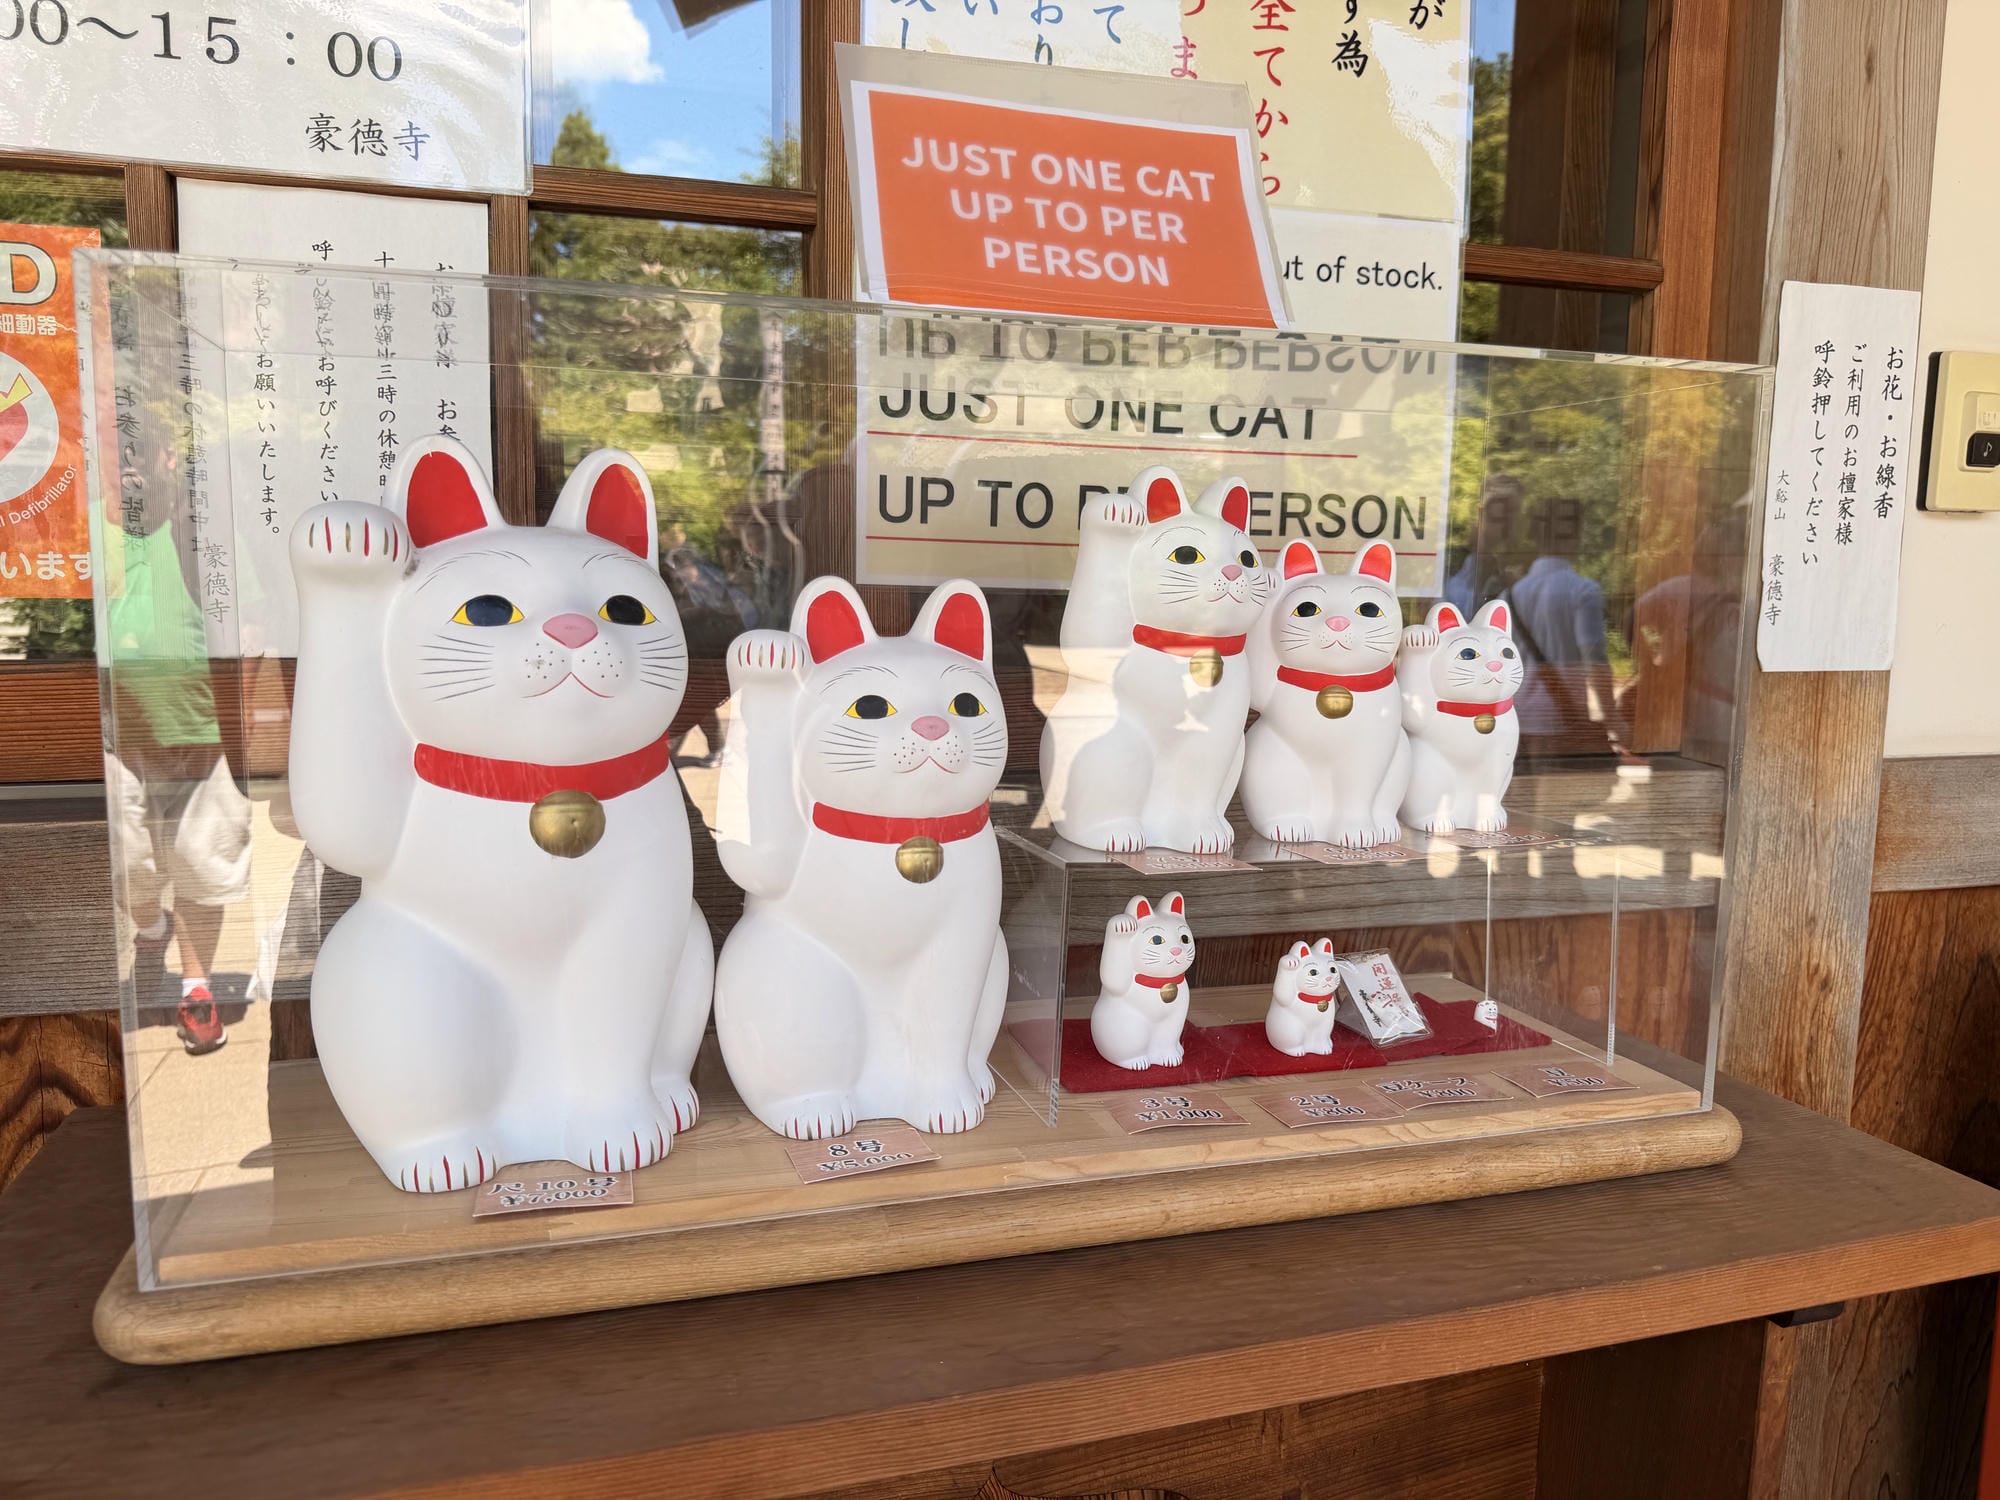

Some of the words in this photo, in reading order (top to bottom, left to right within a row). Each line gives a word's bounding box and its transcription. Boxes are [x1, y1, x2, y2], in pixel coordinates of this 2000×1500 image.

[1093, 5, 1125, 44] て
[902, 137, 1017, 180] JUST
[1031, 153, 1125, 193] ONE
[1135, 166, 1215, 202] CAT
[950, 189, 1013, 223] UP
[1024, 196, 1088, 233] TO
[1101, 205, 1187, 244] PER
[983, 236, 1170, 287] PERSON
[1315, 255, 1347, 284] of
[1356, 261, 1443, 291] stock.
[879, 373, 1032, 426] JUST
[1065, 384, 1184, 434] ONE
[1209, 393, 1327, 441] CAT
[1873, 346, 1905, 519] お花・お線香
[1802, 340, 1835, 565] 呼鈴押してください
[1834, 344, 1867, 546] ご利用のお檀家様
[11, 463, 78, 526] Defibrillator
[879, 474, 955, 525] UP
[977, 480, 1054, 529] TO
[1250, 490, 1427, 541] ERSON
[0, 551, 92, 581] います
[1135, 1108, 1224, 1122] ¥1,000
[817, 1152, 914, 1172] ¥5,000
[500, 1188, 608, 1207] ¥7,000
